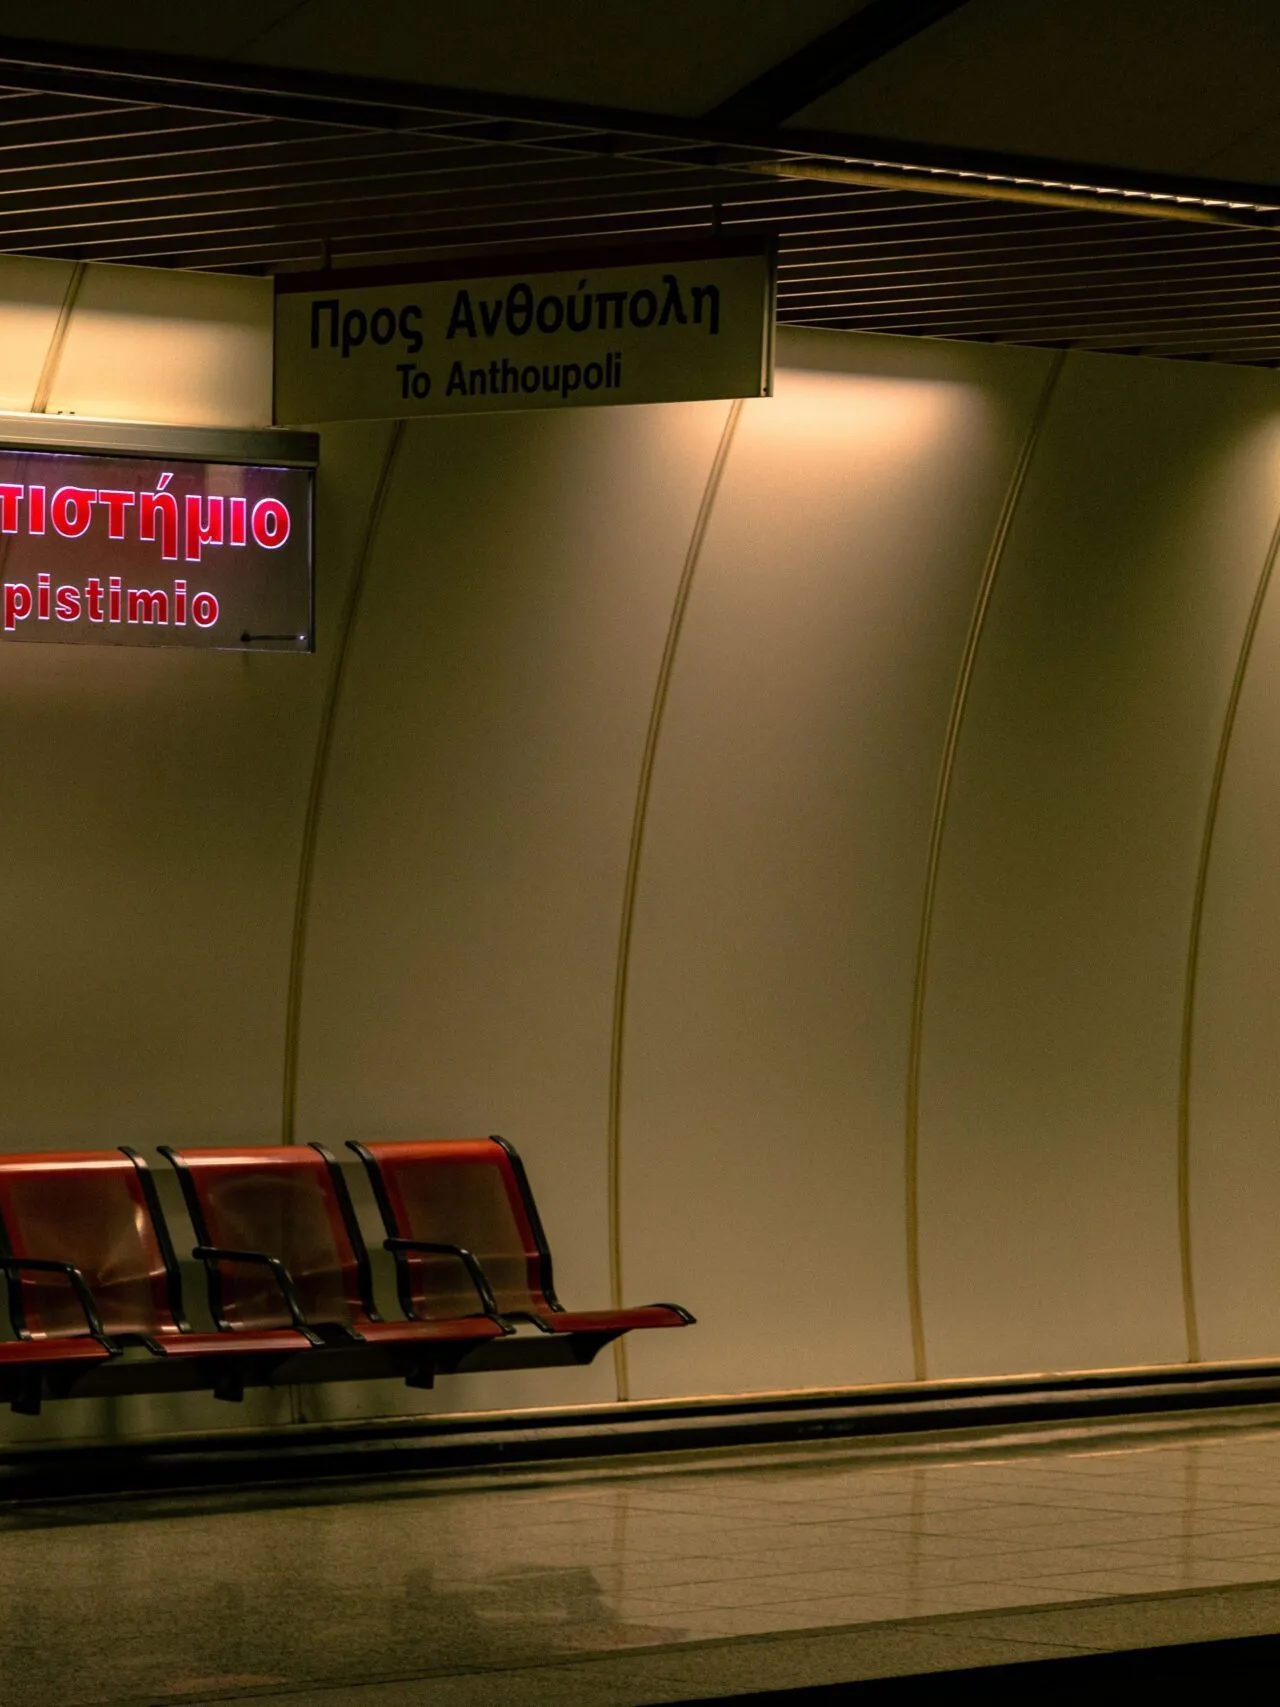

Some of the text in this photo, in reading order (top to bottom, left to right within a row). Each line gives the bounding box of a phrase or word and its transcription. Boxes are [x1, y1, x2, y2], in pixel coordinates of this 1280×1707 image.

[310, 274, 720, 358] Προς Ανθούπολη
[396, 352, 622, 399] To Anthoupoli
